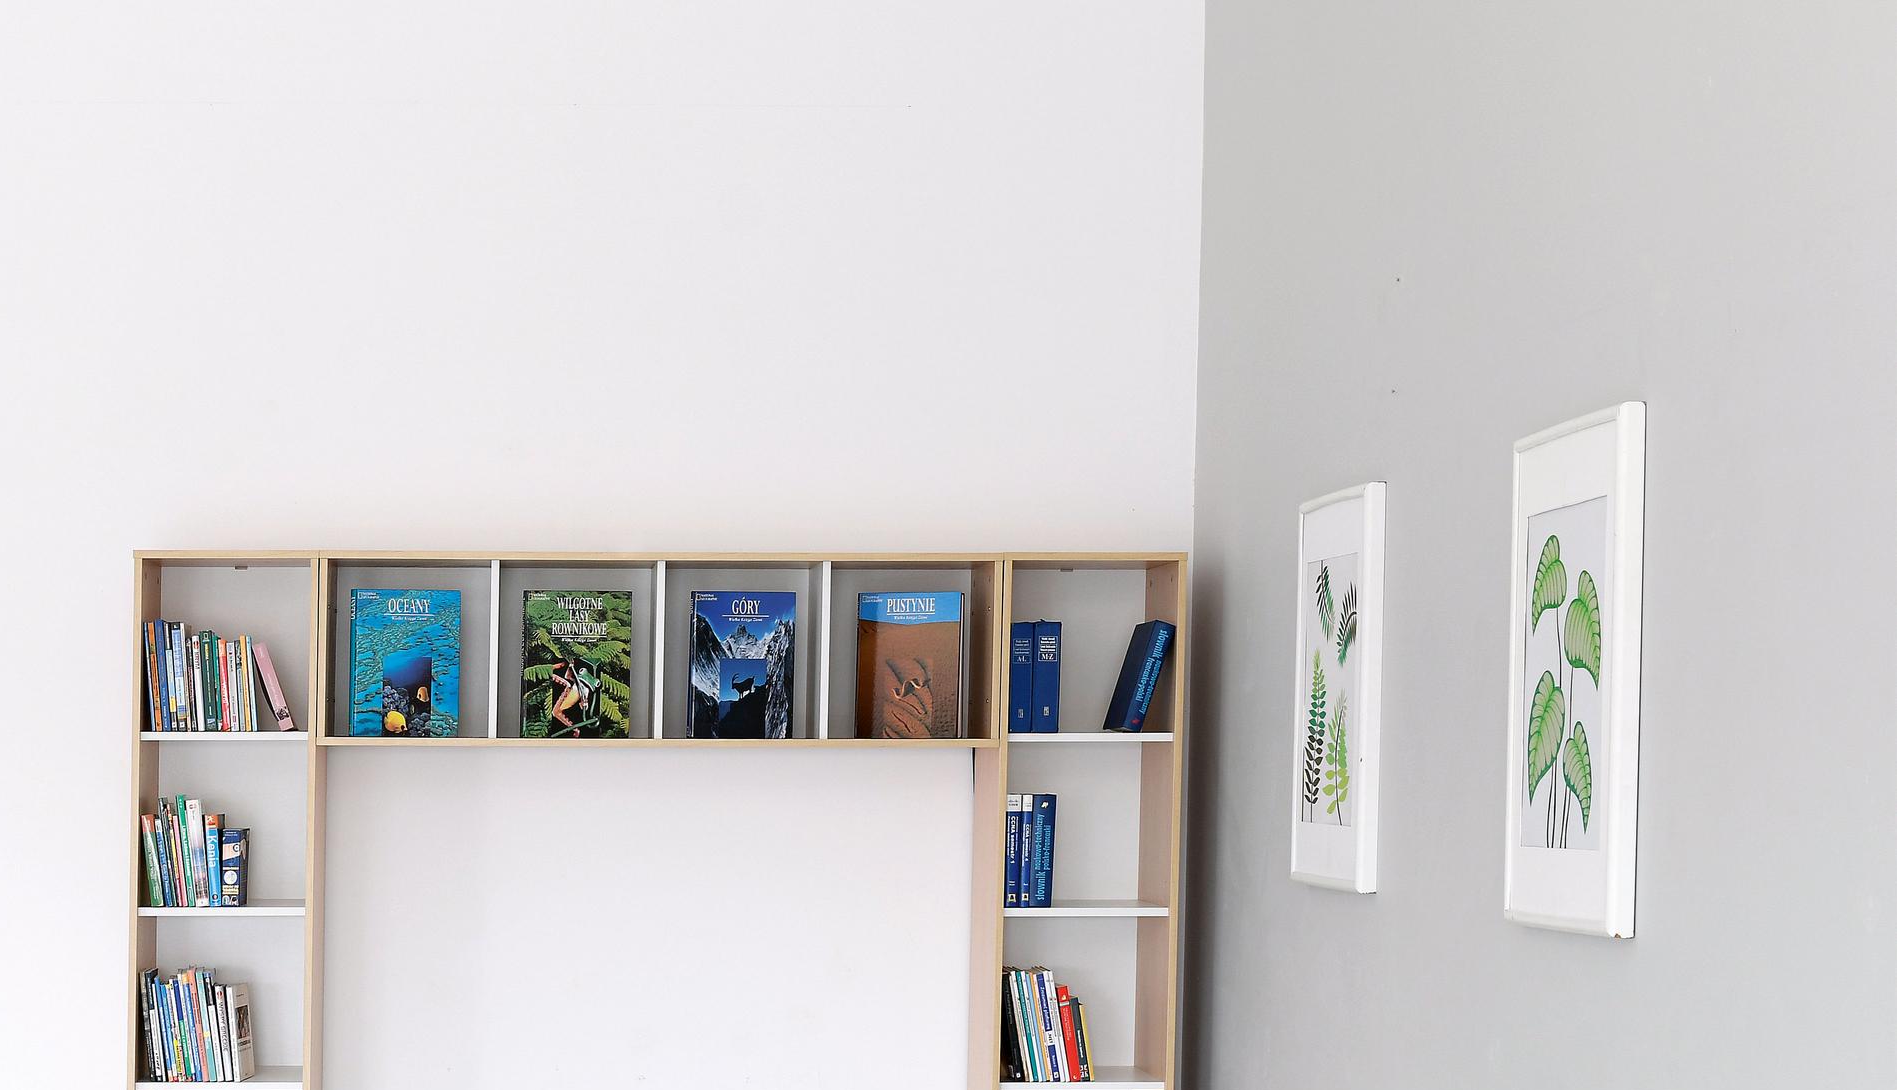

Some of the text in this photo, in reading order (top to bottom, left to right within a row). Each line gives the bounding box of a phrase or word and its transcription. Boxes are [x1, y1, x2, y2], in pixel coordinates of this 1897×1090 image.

[388, 599, 430, 613] OCEANY
[556, 597, 603, 610] WILGOTNE
[732, 596, 760, 614] GÓRY
[887, 598, 936, 612] PUSTYNIE
[570, 610, 590, 622] LASY
[1152, 630, 1168, 658] słownik
[207, 834, 218, 868] Kenia
[1035, 871, 1046, 900] słownik
